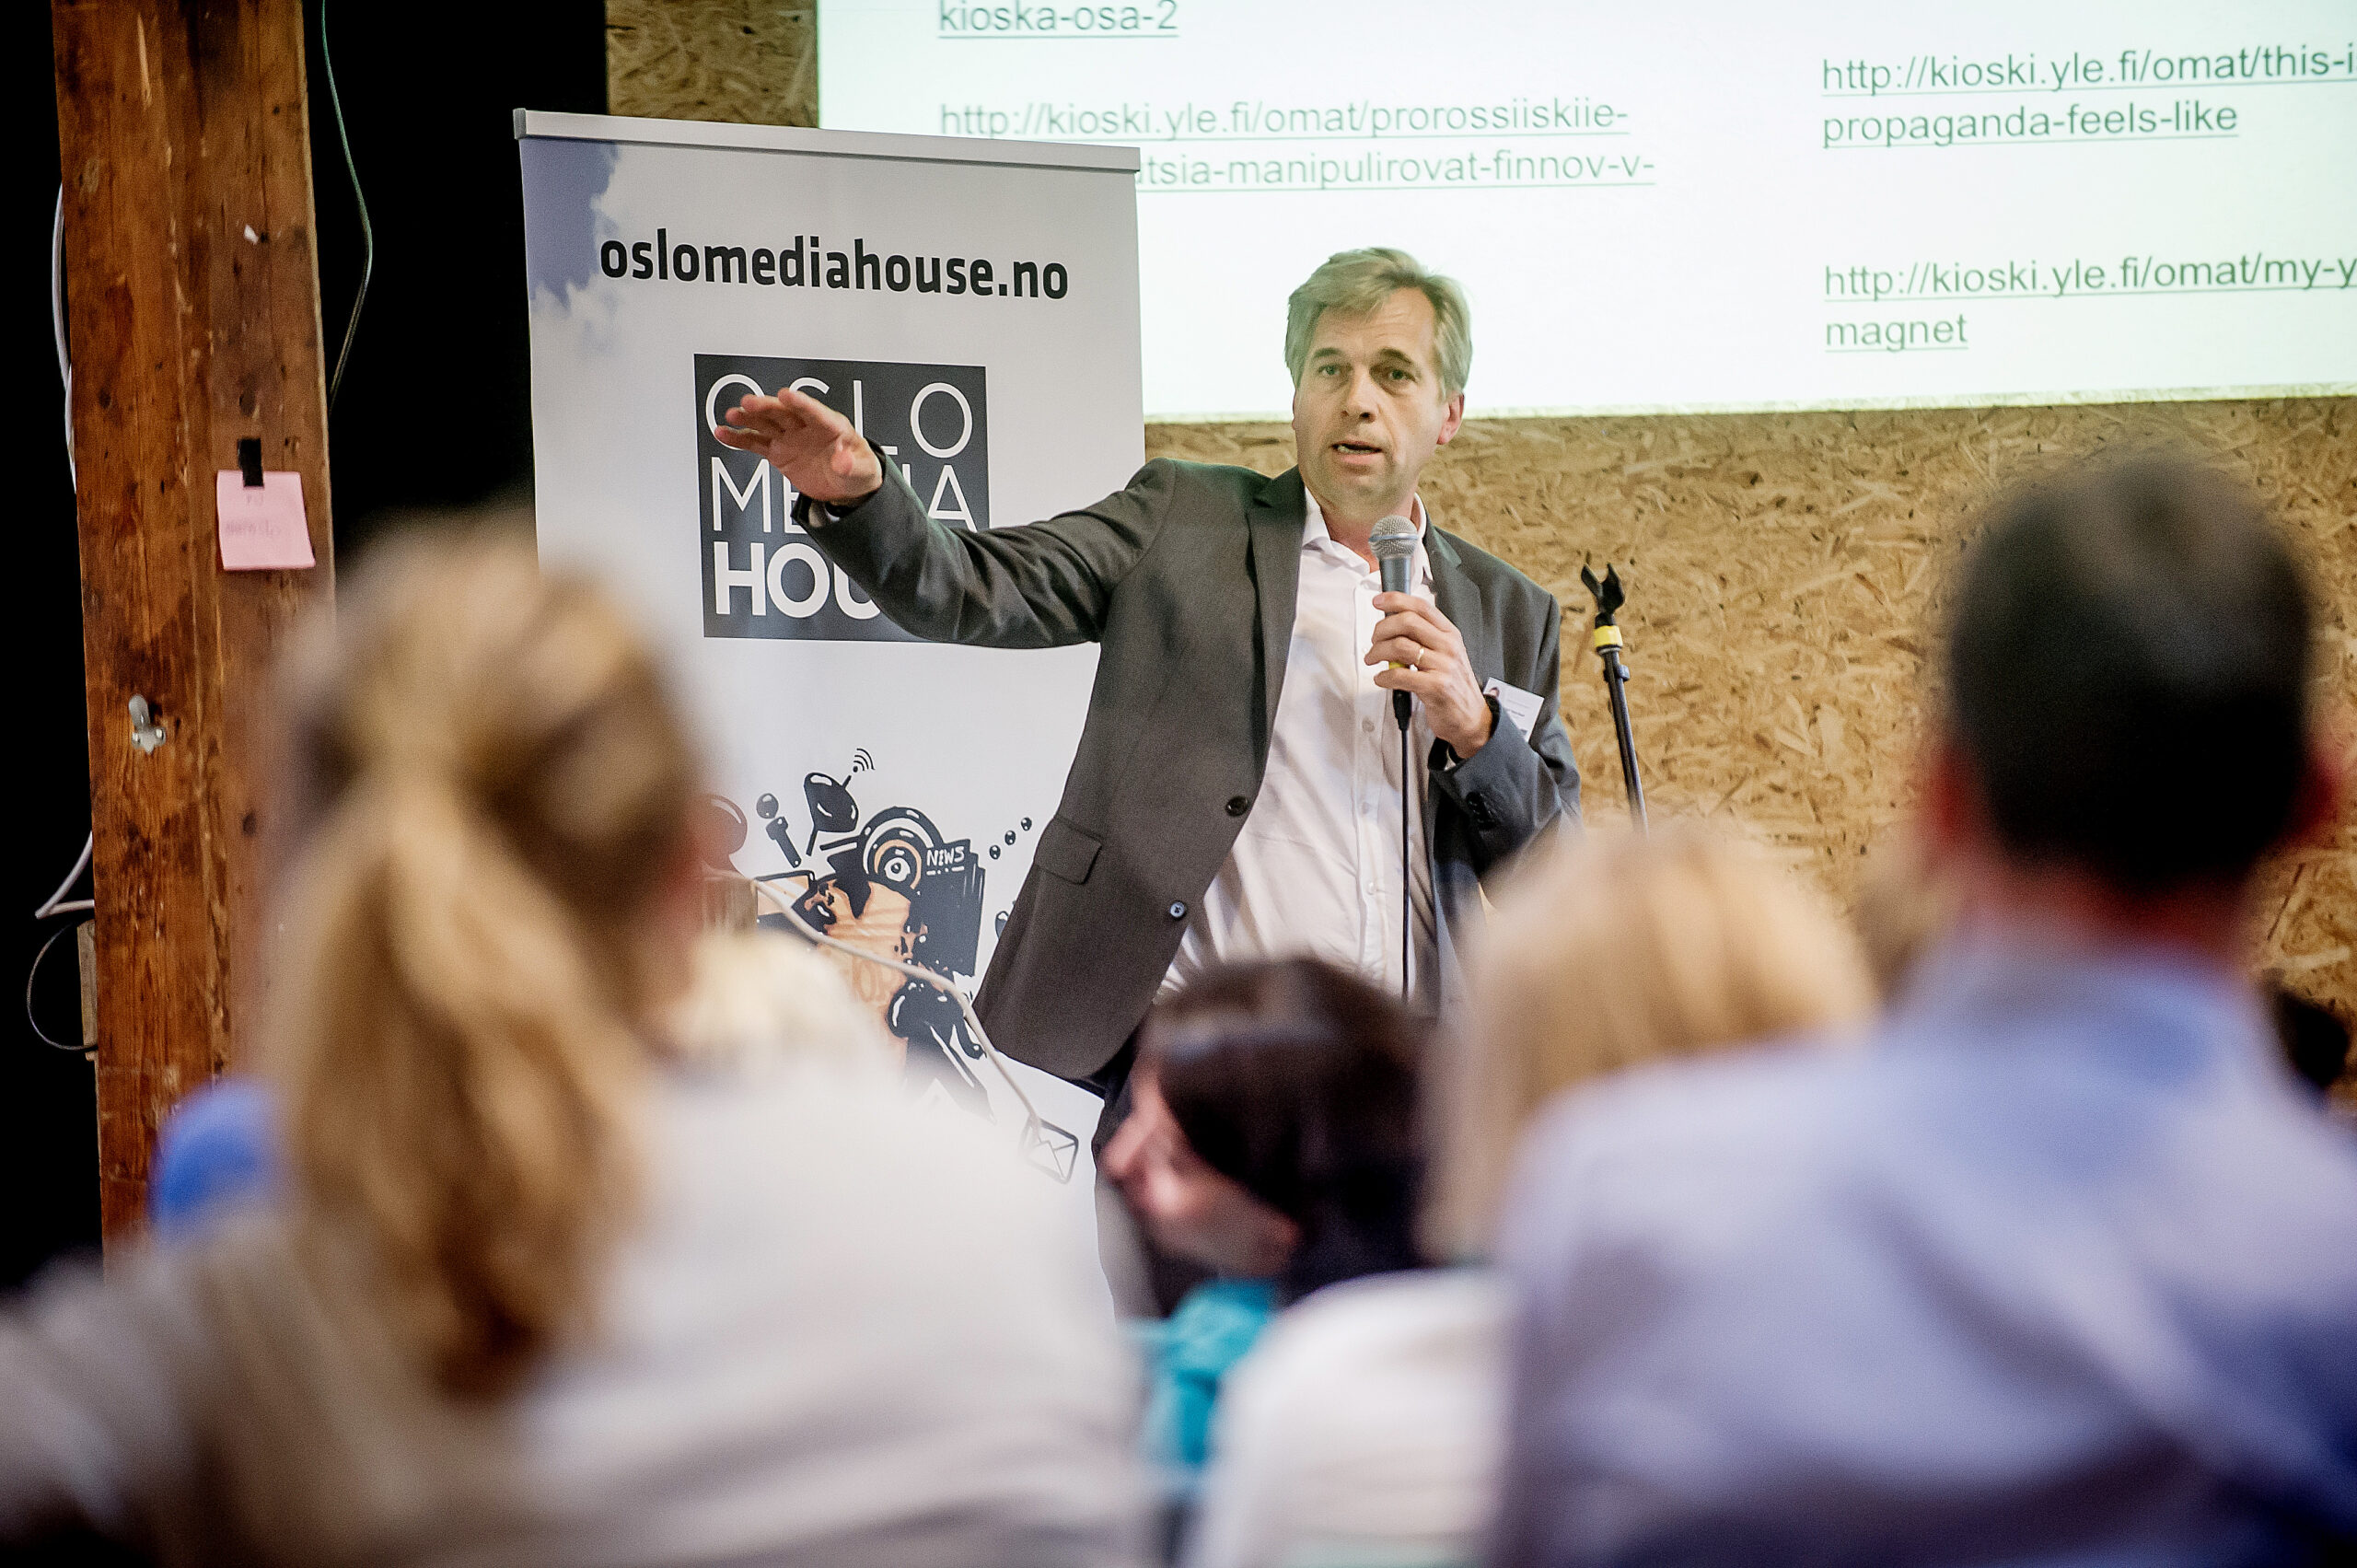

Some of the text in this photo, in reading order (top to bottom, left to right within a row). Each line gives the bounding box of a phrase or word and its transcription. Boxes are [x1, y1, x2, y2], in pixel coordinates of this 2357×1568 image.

[939, 0, 1178, 30] kioska-osa-2
[1822, 42, 2357, 96] http://kioski.yle.fi/omat/this-i
[941, 98, 1629, 140] http://kioski.yle.fi/omat/prorossiiskiie-
[1822, 100, 2239, 147] propaganda-feels-like
[1137, 151, 1655, 188] tsia-manipulirovat-finnov-v-
[599, 227, 1069, 299] oslomediahouse.no
[1825, 313, 1968, 352] magnet
[926, 845, 965, 866] NEWS
